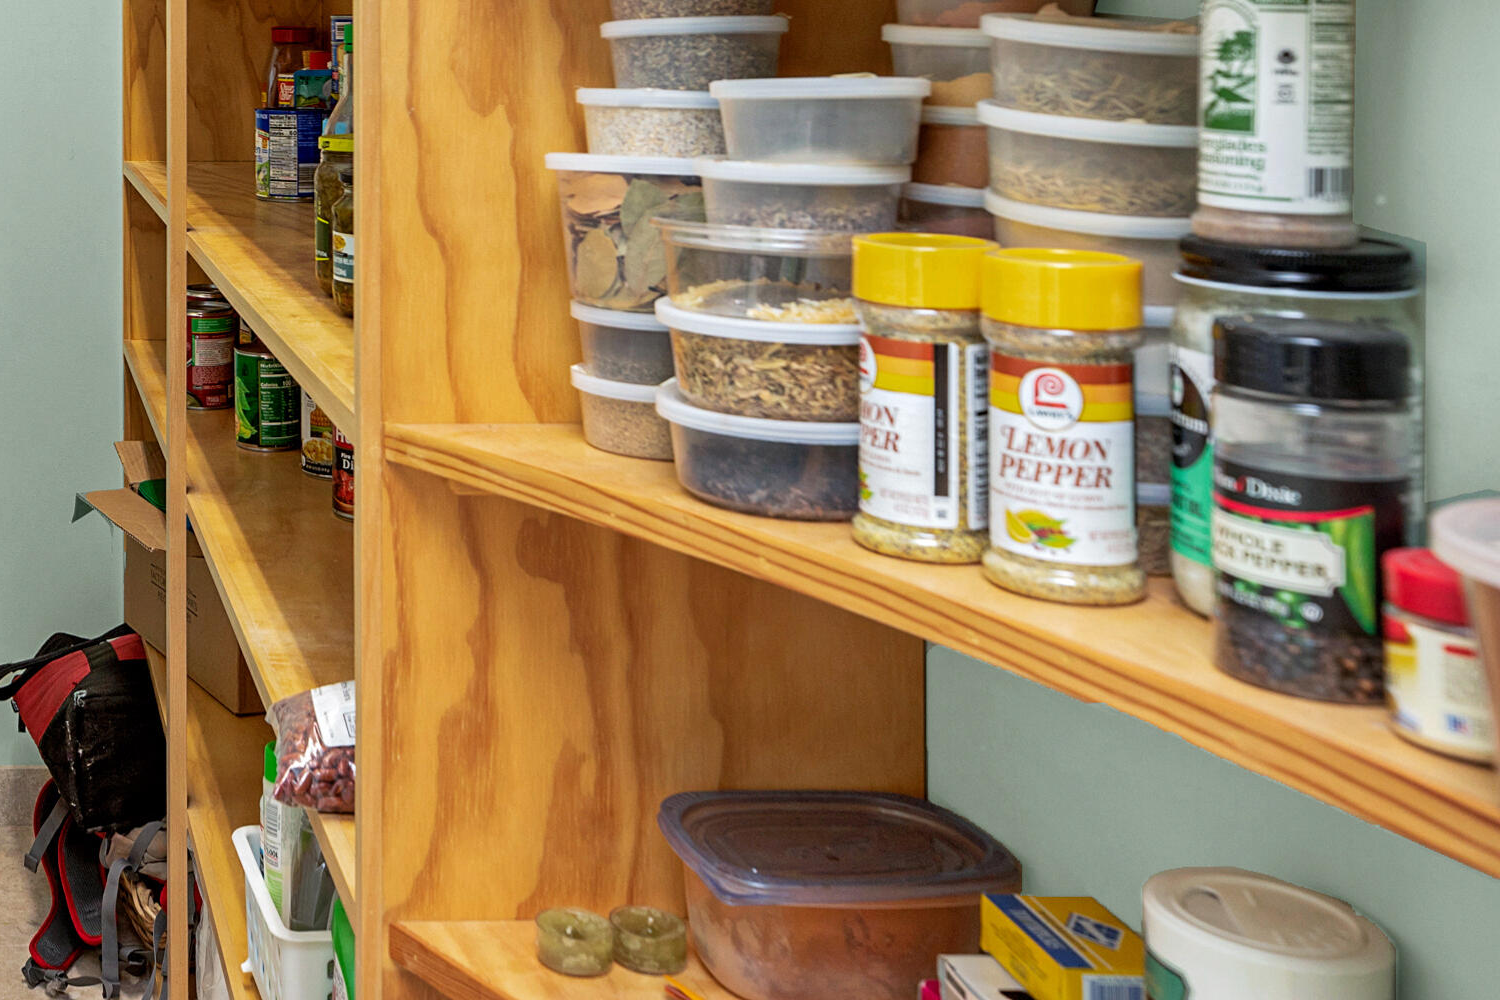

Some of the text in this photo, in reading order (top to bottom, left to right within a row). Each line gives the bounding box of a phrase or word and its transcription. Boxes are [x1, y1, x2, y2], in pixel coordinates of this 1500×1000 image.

[1000, 424, 1112, 461] LEMON
[999, 453, 1113, 490] PEPPER
[1242, 544, 1329, 581] PEPPER
